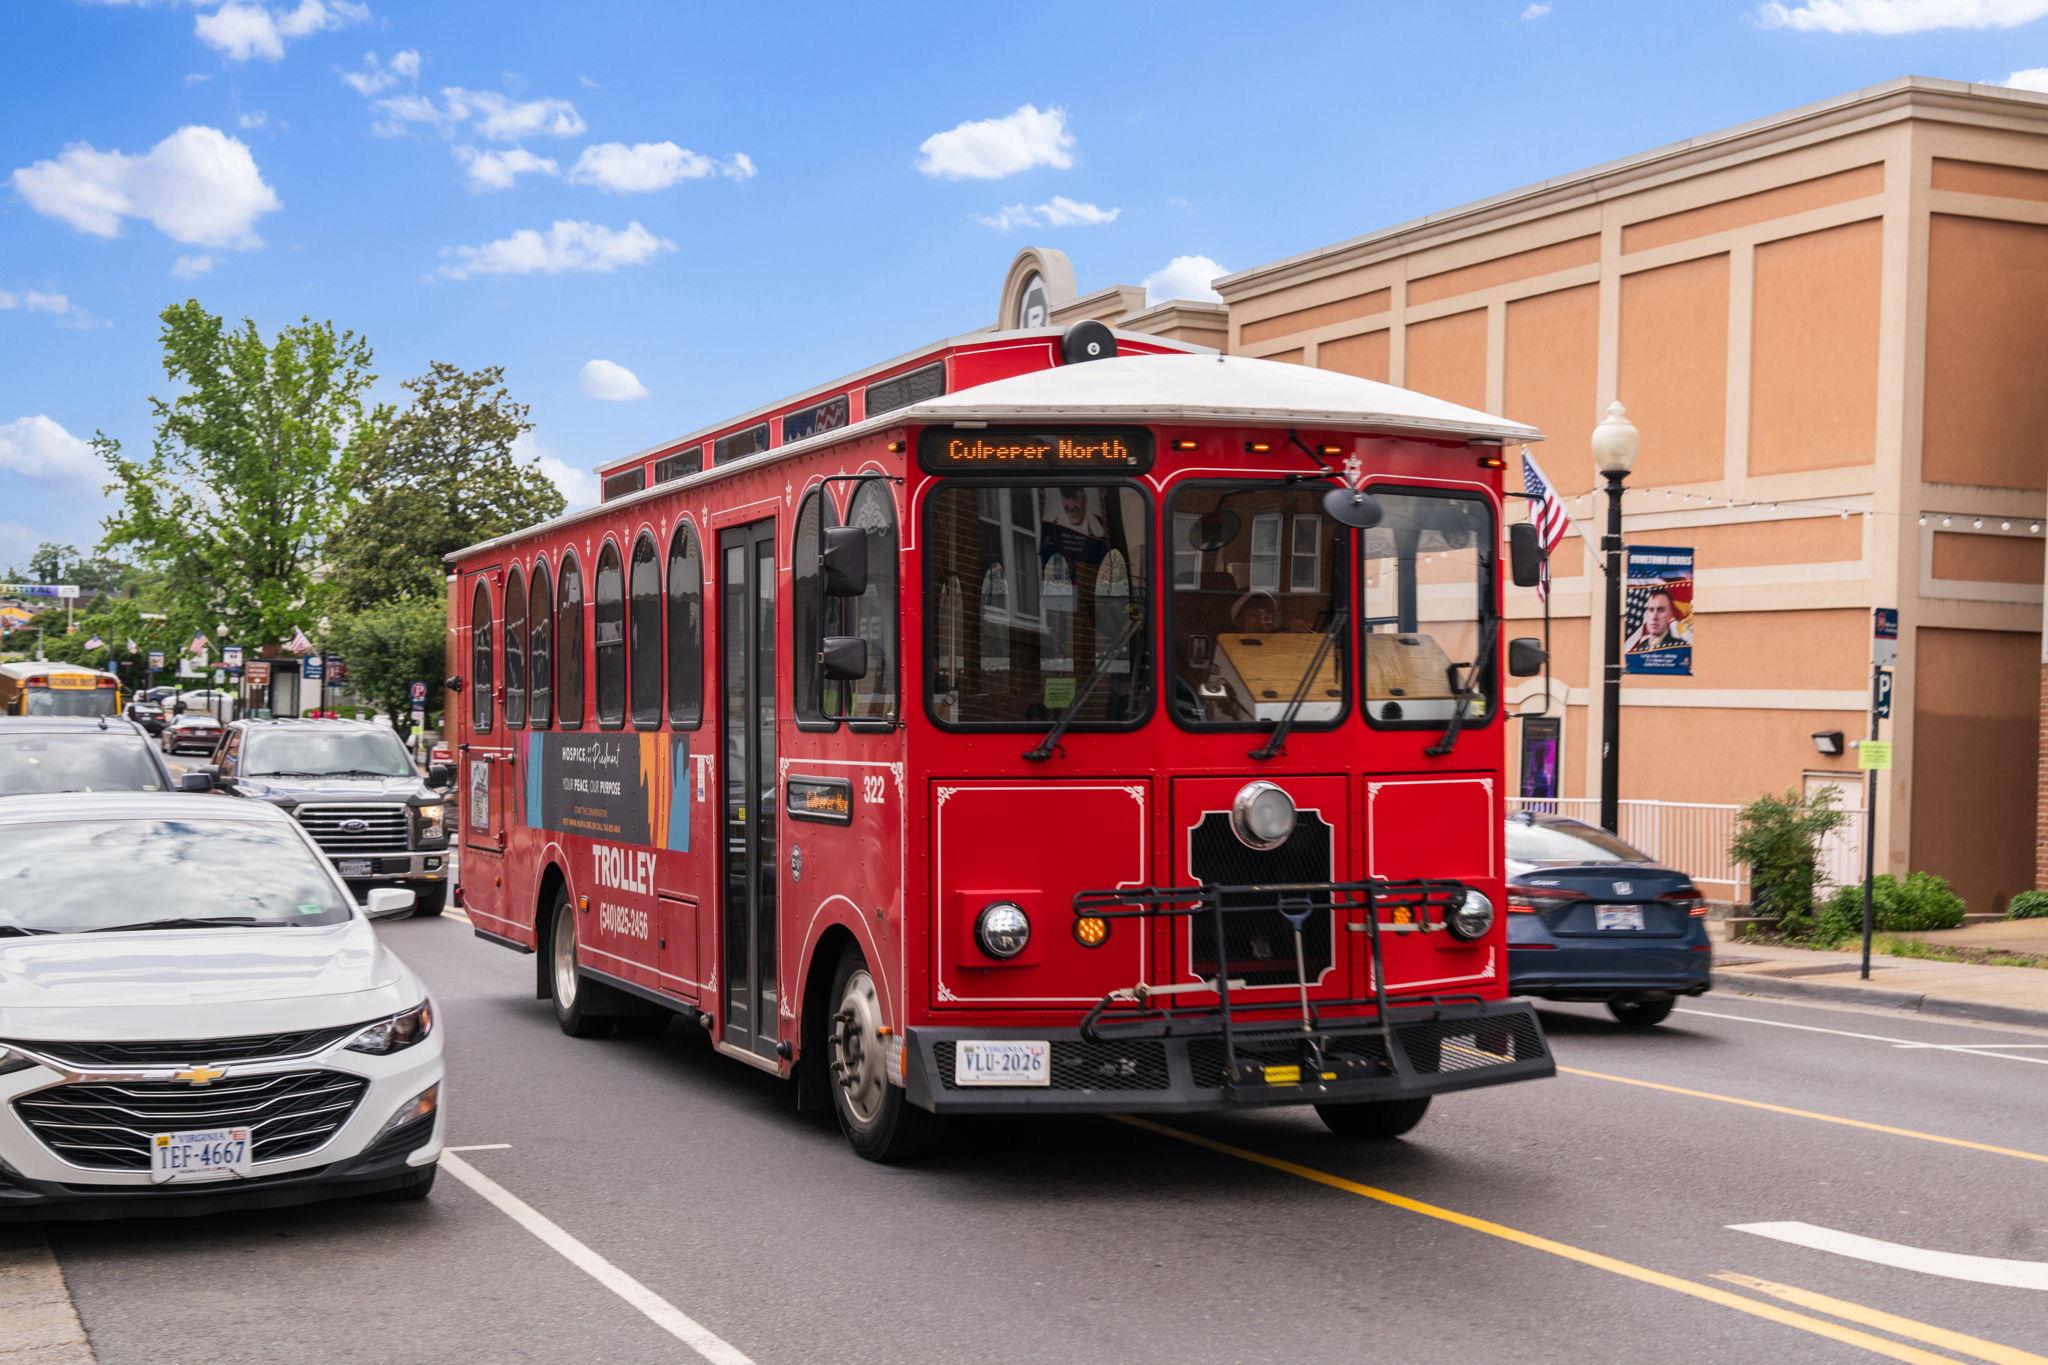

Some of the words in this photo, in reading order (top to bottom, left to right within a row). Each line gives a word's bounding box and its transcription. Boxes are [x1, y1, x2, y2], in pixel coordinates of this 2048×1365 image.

[949, 440, 1050, 459] Culpeper
[1058, 440, 1128, 459] North
[1879, 674, 1891, 702] P
[562, 746, 586, 762] HOSPICE
[562, 777, 574, 791] YOUR
[590, 780, 600, 794] OUR
[600, 781, 621, 796] PURPOSE
[863, 775, 885, 803] 322
[592, 844, 657, 896] TROLLEY
[966, 1053, 1041, 1071] VLU-2026
[160, 1141, 244, 1168] TEF-4667
